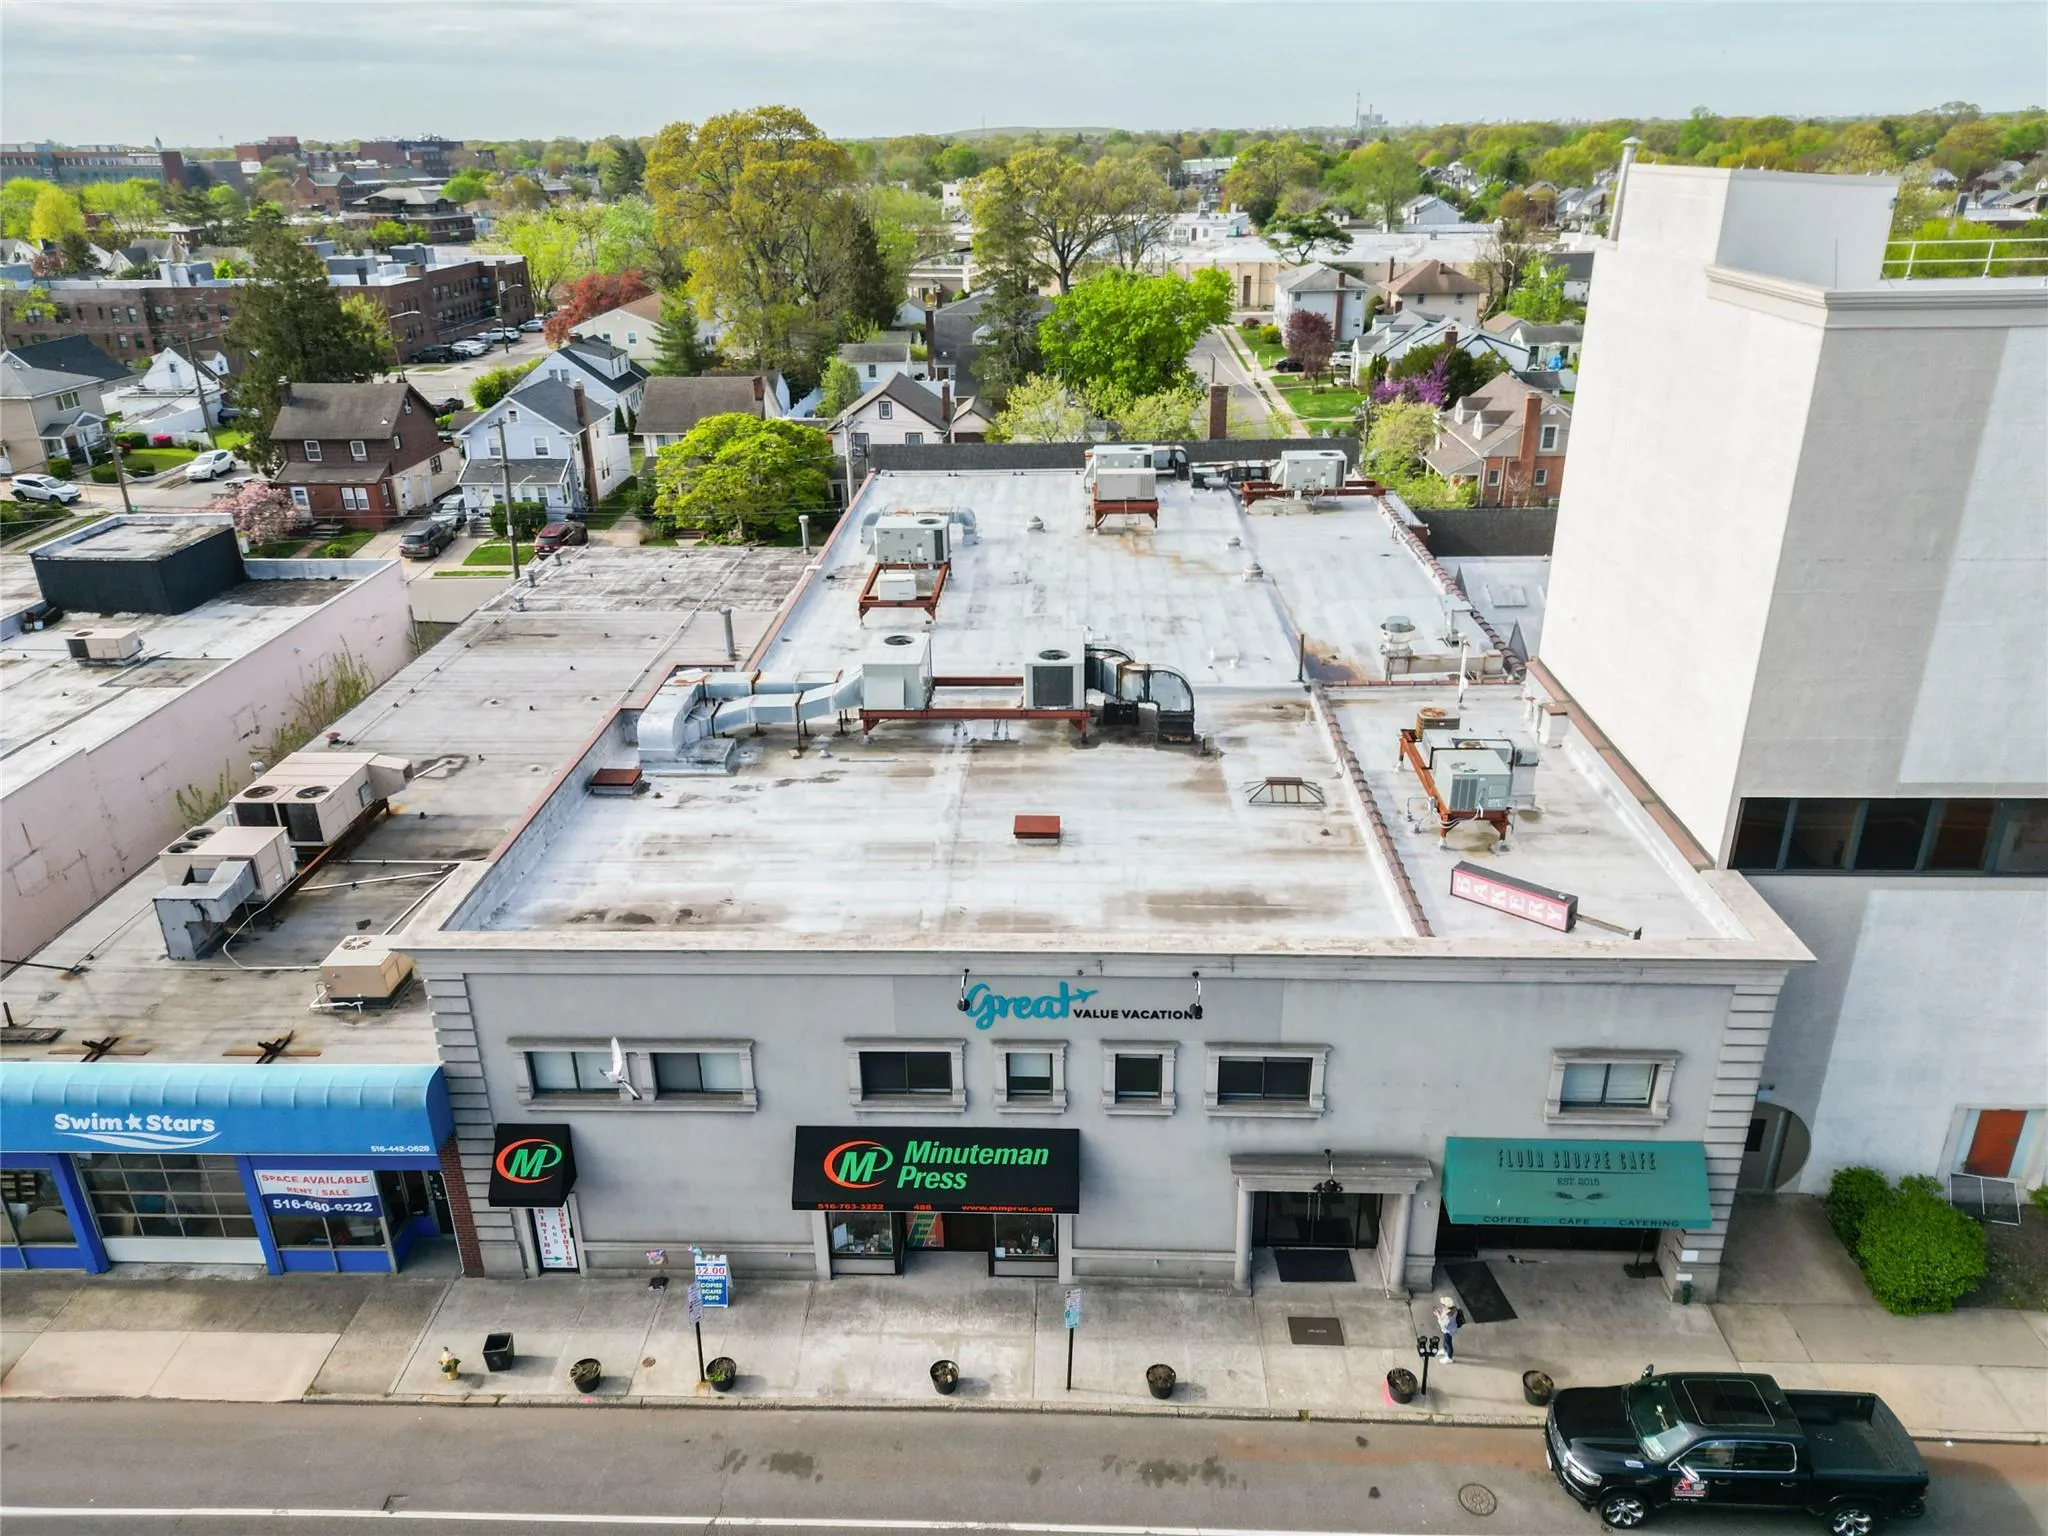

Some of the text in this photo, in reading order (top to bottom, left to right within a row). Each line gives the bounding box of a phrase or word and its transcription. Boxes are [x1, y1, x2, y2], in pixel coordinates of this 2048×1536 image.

[1456, 875, 1563, 920] BAKERY
[966, 981, 1074, 1030] Great
[1073, 1008, 1119, 1020] VALUE
[54, 1112, 216, 1132] Swim Stars
[903, 1140, 1049, 1165] Minuteman
[1498, 1149, 1657, 1171] FLOUR SHOPPE CAFE
[261, 1174, 369, 1184] SPACE AVAILABLE
[896, 1165, 968, 1189] Press
[286, 1186, 313, 1195] RENT
[272, 1199, 374, 1212] 516-680-6222
[961, 1204, 1054, 1213] www.mmprvc.com
[1483, 1216, 1531, 1224] COFFEE
[1618, 1219, 1680, 1227] CATERING
